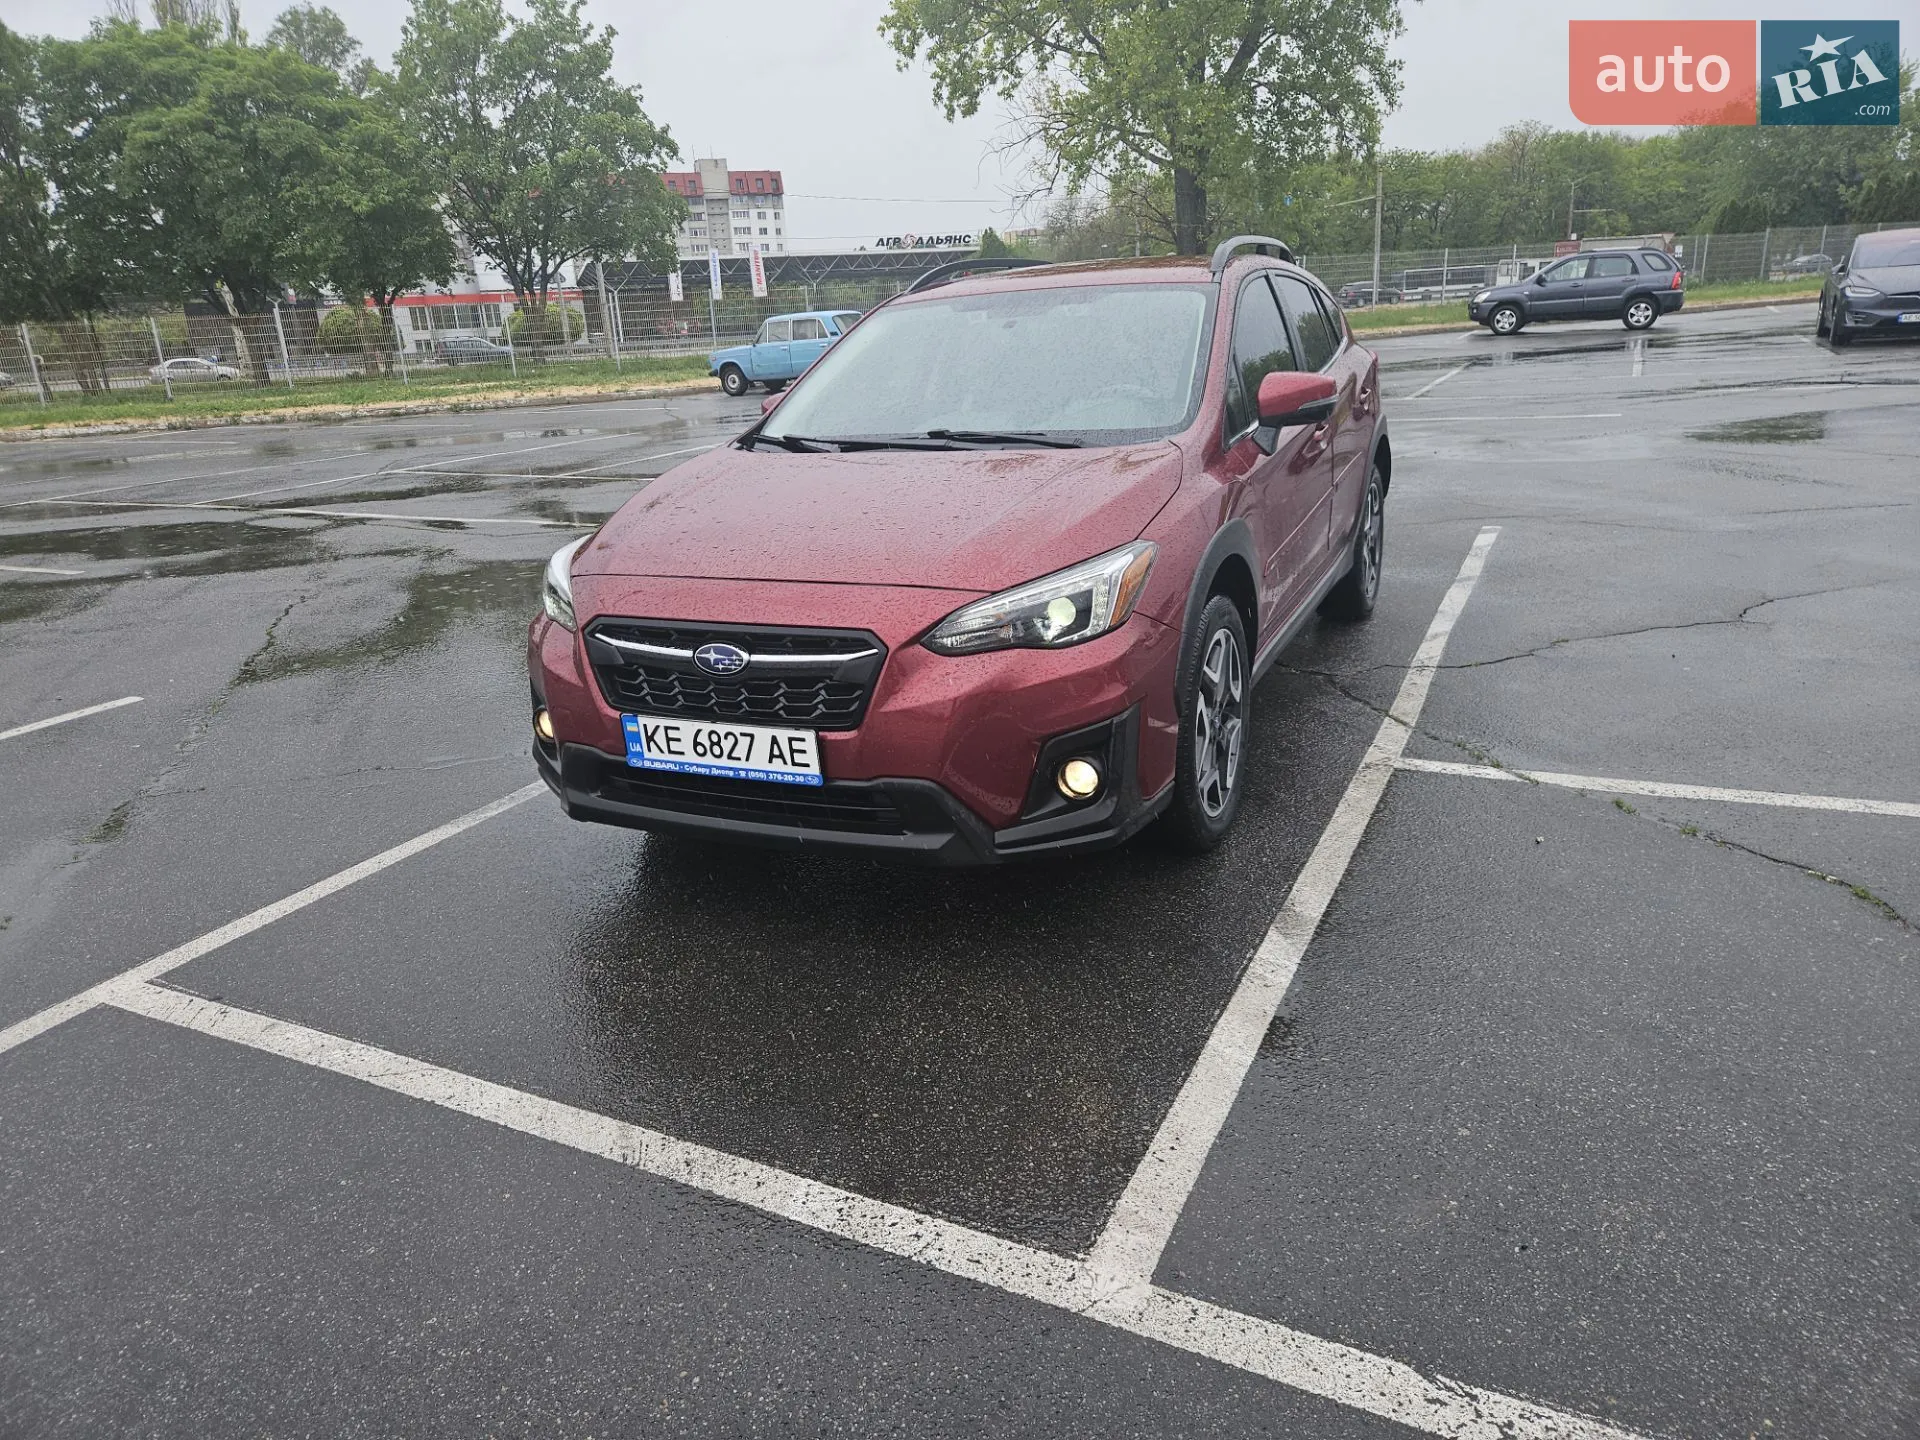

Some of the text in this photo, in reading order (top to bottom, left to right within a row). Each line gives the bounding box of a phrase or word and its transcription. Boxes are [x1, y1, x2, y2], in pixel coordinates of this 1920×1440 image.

[629, 742, 642, 753] UA
[643, 723, 811, 768] KE 6827 AE
[643, 760, 680, 771] SUBARU
